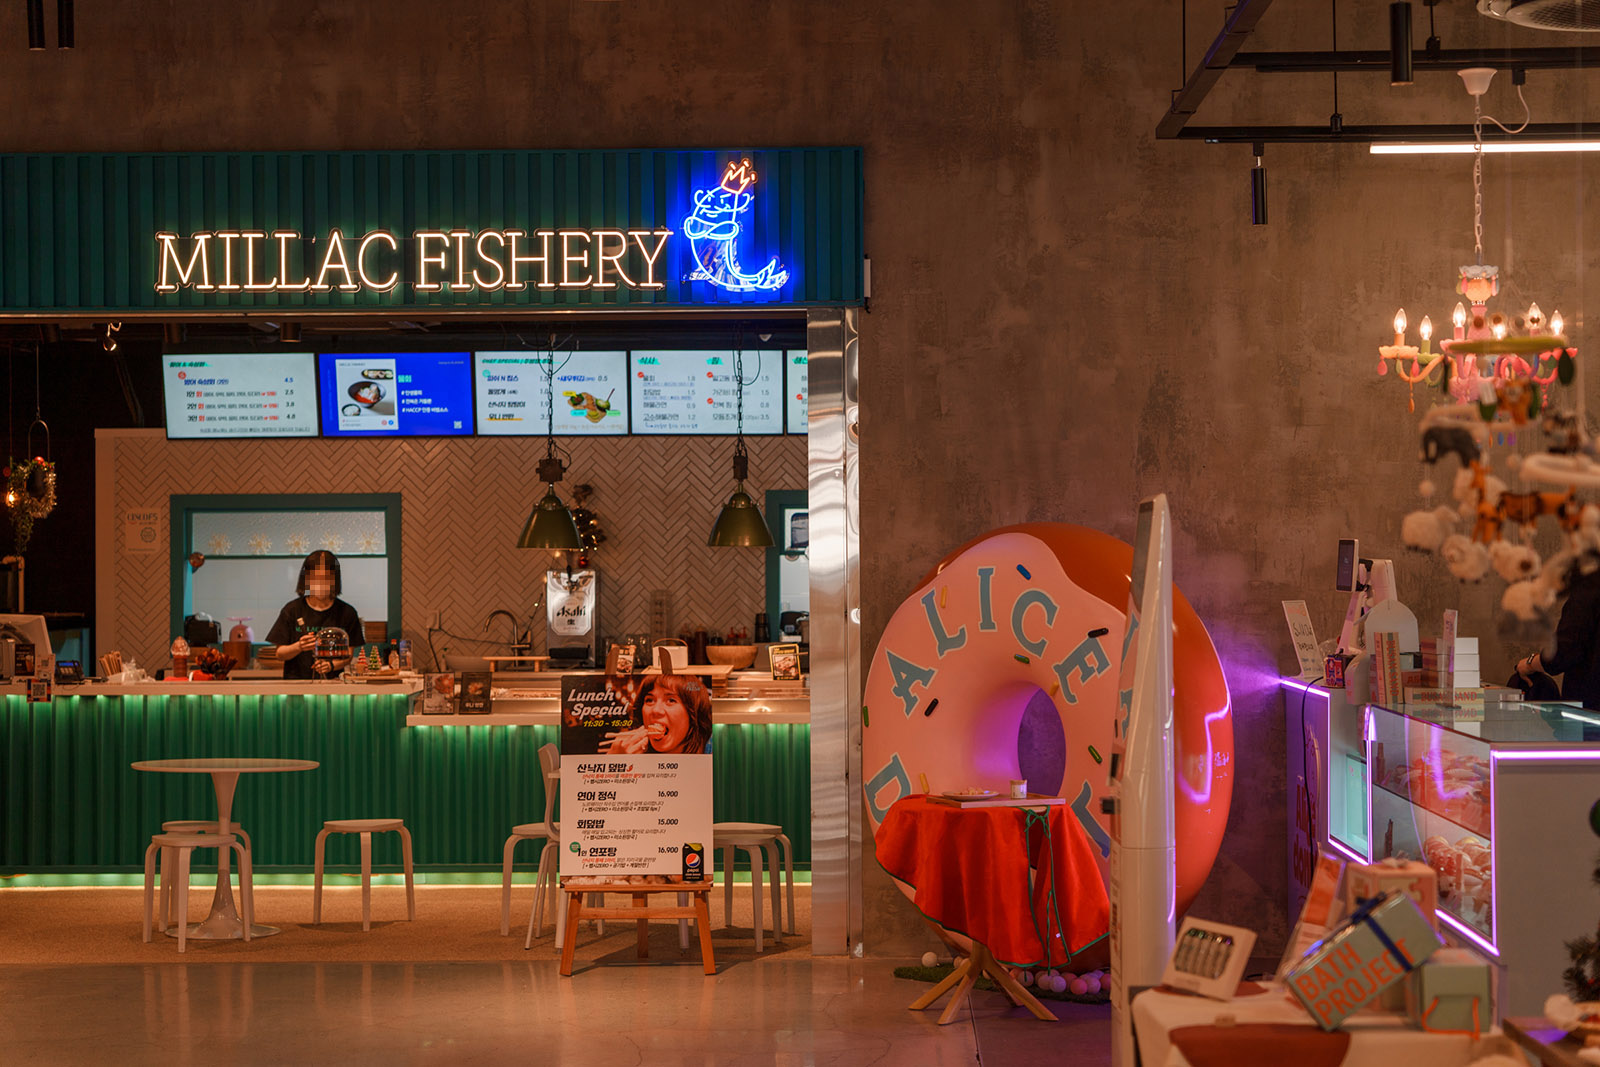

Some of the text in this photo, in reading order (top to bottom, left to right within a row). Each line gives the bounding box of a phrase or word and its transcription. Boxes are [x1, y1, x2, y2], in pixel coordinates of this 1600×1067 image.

[156, 230, 674, 291] MILLAC FISHERY
[556, 605, 586, 617] Asahi
[885, 566, 1112, 720] ALICE
[567, 687, 615, 702] Lunch
[571, 701, 630, 721] Special
[583, 719, 604, 727] 11:30
[611, 719, 633, 727] 15:30
[577, 763, 627, 773] 산낙지 덮밥
[577, 791, 616, 801] 연어 정식
[577, 819, 605, 829] 회덮밥
[589, 847, 617, 857] 연포탕
[1295, 941, 1362, 1002] BATH
[1312, 937, 1416, 1026] PROJECT
